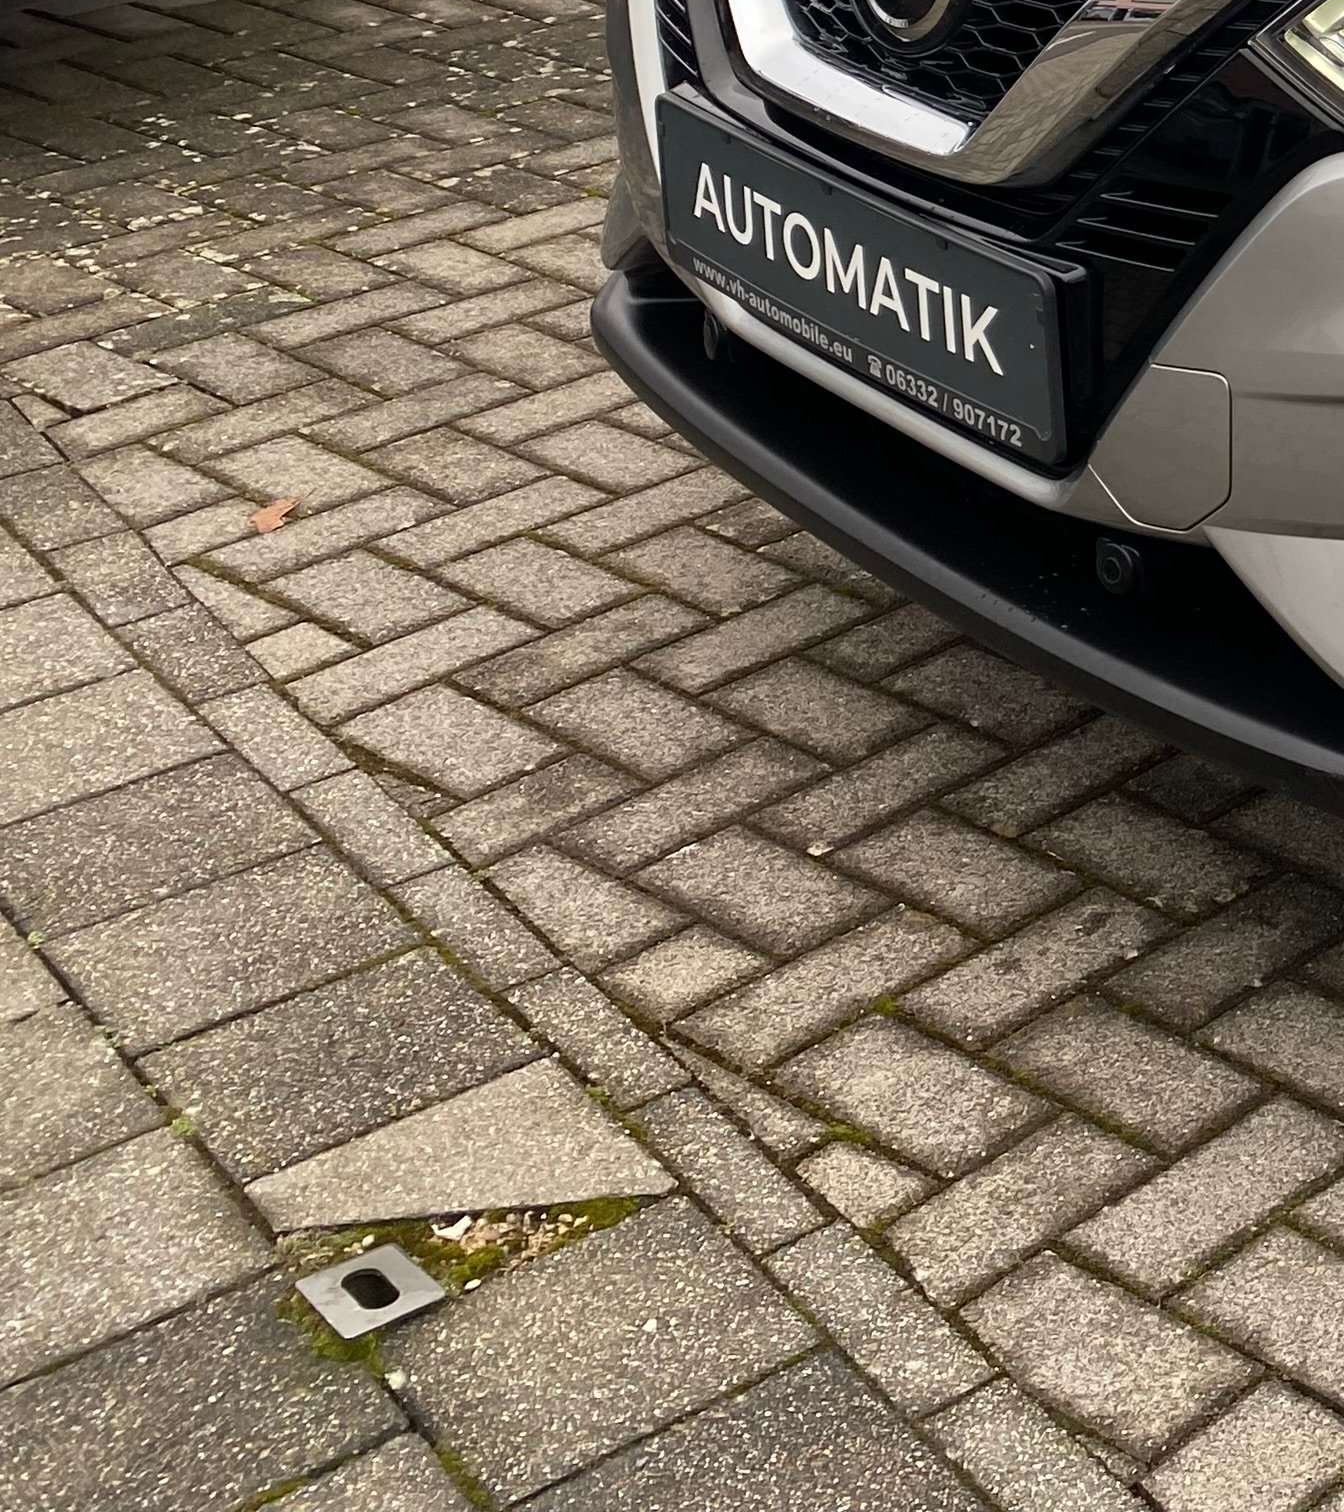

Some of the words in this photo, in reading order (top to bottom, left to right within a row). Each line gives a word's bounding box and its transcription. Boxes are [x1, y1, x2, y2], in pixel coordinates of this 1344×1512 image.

[692, 256, 853, 363] www.vh-automobile.eu
[885, 364, 938, 408] 06332
[952, 398, 1022, 448] 907172
[693, 162, 1004, 377] AUTOMATIK
